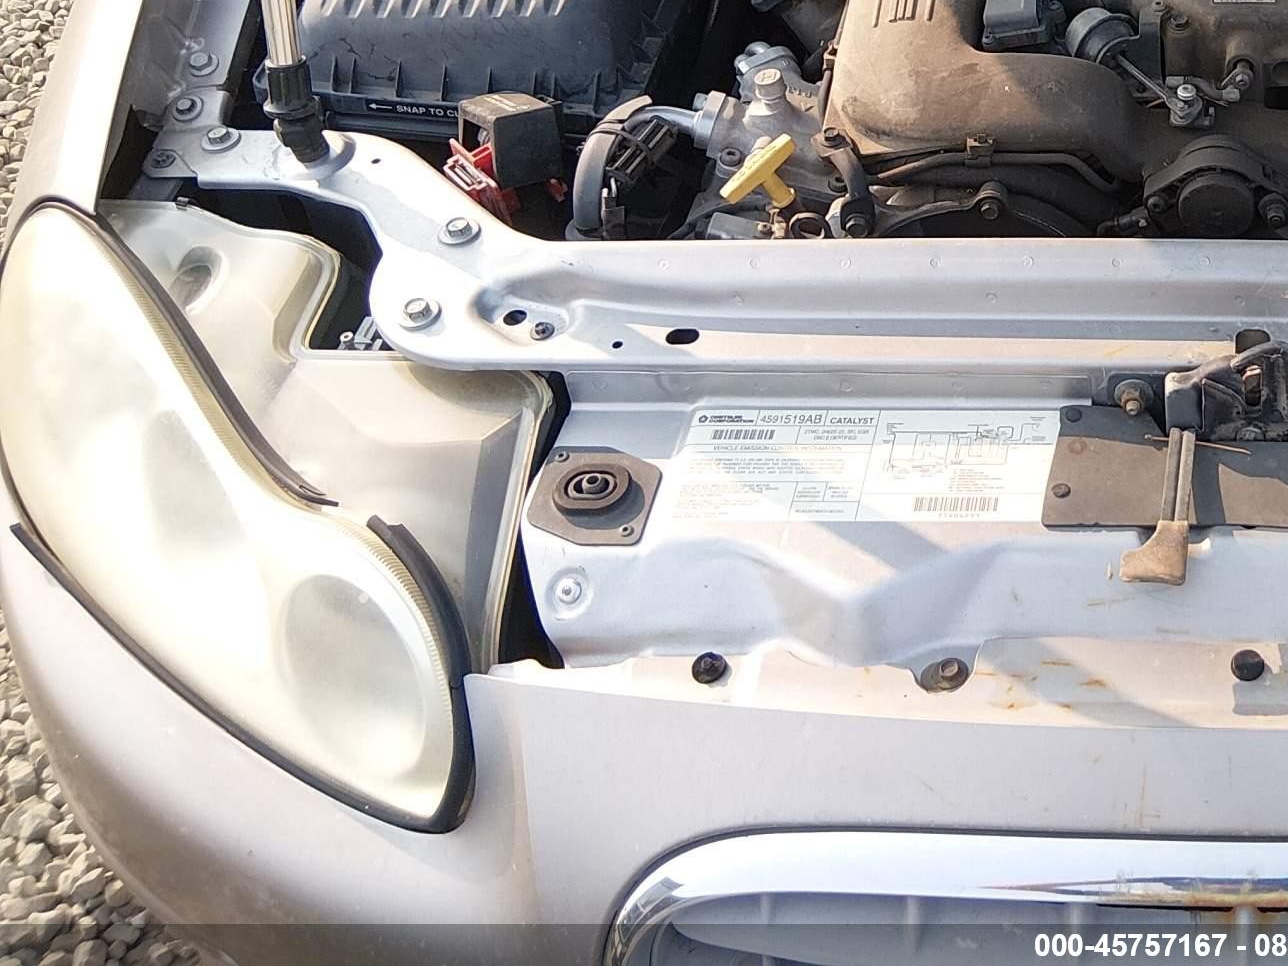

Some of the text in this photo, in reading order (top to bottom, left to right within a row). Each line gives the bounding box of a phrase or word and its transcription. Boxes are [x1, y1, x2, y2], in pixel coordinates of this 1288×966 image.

[396, 105, 426, 114] SNAP
[429, 108, 444, 116] TO
[760, 414, 875, 425] 4591519AB CATALYST
